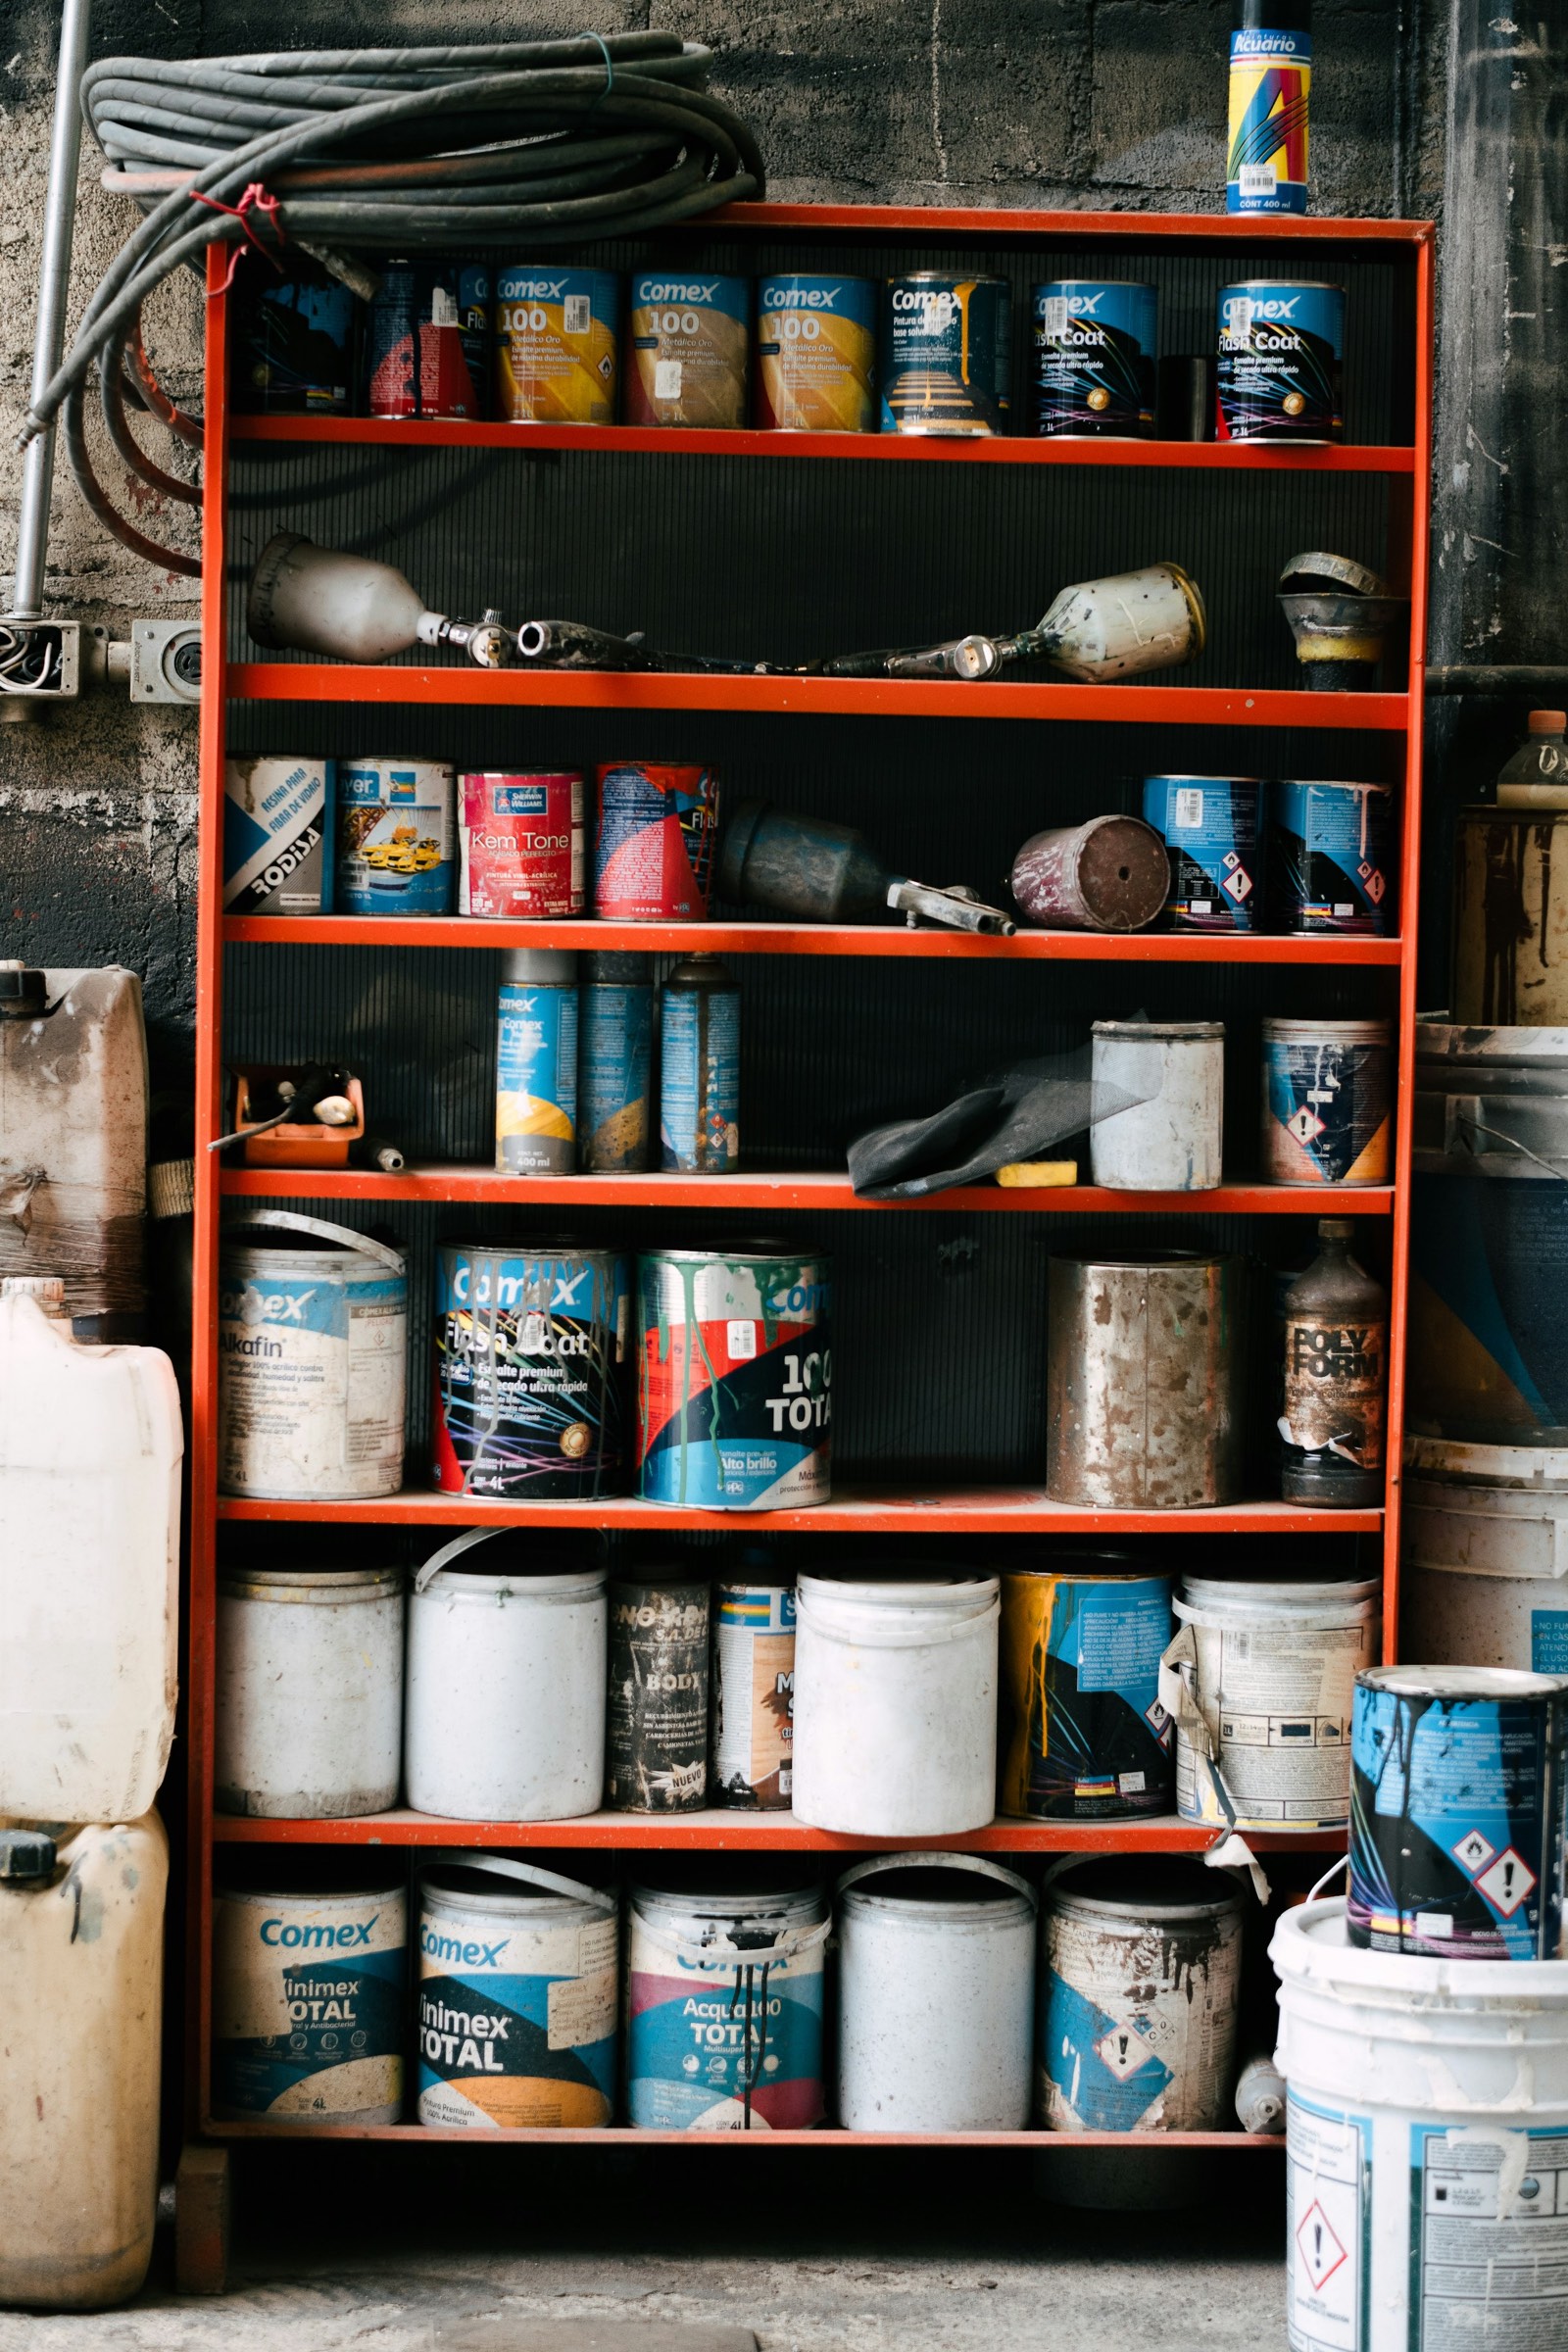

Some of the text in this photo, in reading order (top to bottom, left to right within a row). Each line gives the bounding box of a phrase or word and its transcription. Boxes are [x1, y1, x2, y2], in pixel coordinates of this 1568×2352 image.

[1239, 200, 1291, 209] CONT 400 ml
[497, 277, 569, 298] Comex
[639, 281, 720, 302] Comex
[763, 286, 842, 308] Comex
[1033, 291, 1105, 315] Coex
[503, 309, 547, 331] 100
[649, 312, 700, 334] 100
[771, 317, 820, 340] 100
[893, 316, 916, 325] Pintura
[893, 327, 906, 337] base
[1060, 327, 1105, 346] Coat
[1255, 332, 1301, 351] Coat
[1060, 352, 1089, 362] premium
[1082, 360, 1103, 370] rápido
[1255, 356, 1285, 366] premium
[1278, 364, 1299, 374] rápido
[261, 767, 308, 813] RESINA PARA
[299, 777, 321, 807] VIDRIO
[512, 792, 543, 801] SHERWIN
[471, 831, 569, 850] Kem Tone
[516, 1156, 550, 1167] 400 ml
[453, 1267, 589, 1306] Comx
[1294, 1327, 1369, 1353] POLY
[477, 1362, 517, 1377] Esalte
[1294, 1352, 1379, 1378] FORM
[476, 1379, 489, 1391] de
[557, 1380, 588, 1395] rápido
[721, 1456, 777, 1469] Alto brillo
[489, 1476, 505, 1490] 4L
[646, 1672, 698, 1691] BODY
[671, 1767, 702, 1789] NUEVO
[260, 1913, 380, 1948] Comex
[418, 1923, 511, 1967] Comex
[287, 1999, 356, 2022] OTAL
[311, 2020, 356, 2029] Antibacterial
[442, 2102, 475, 2118] Premium
